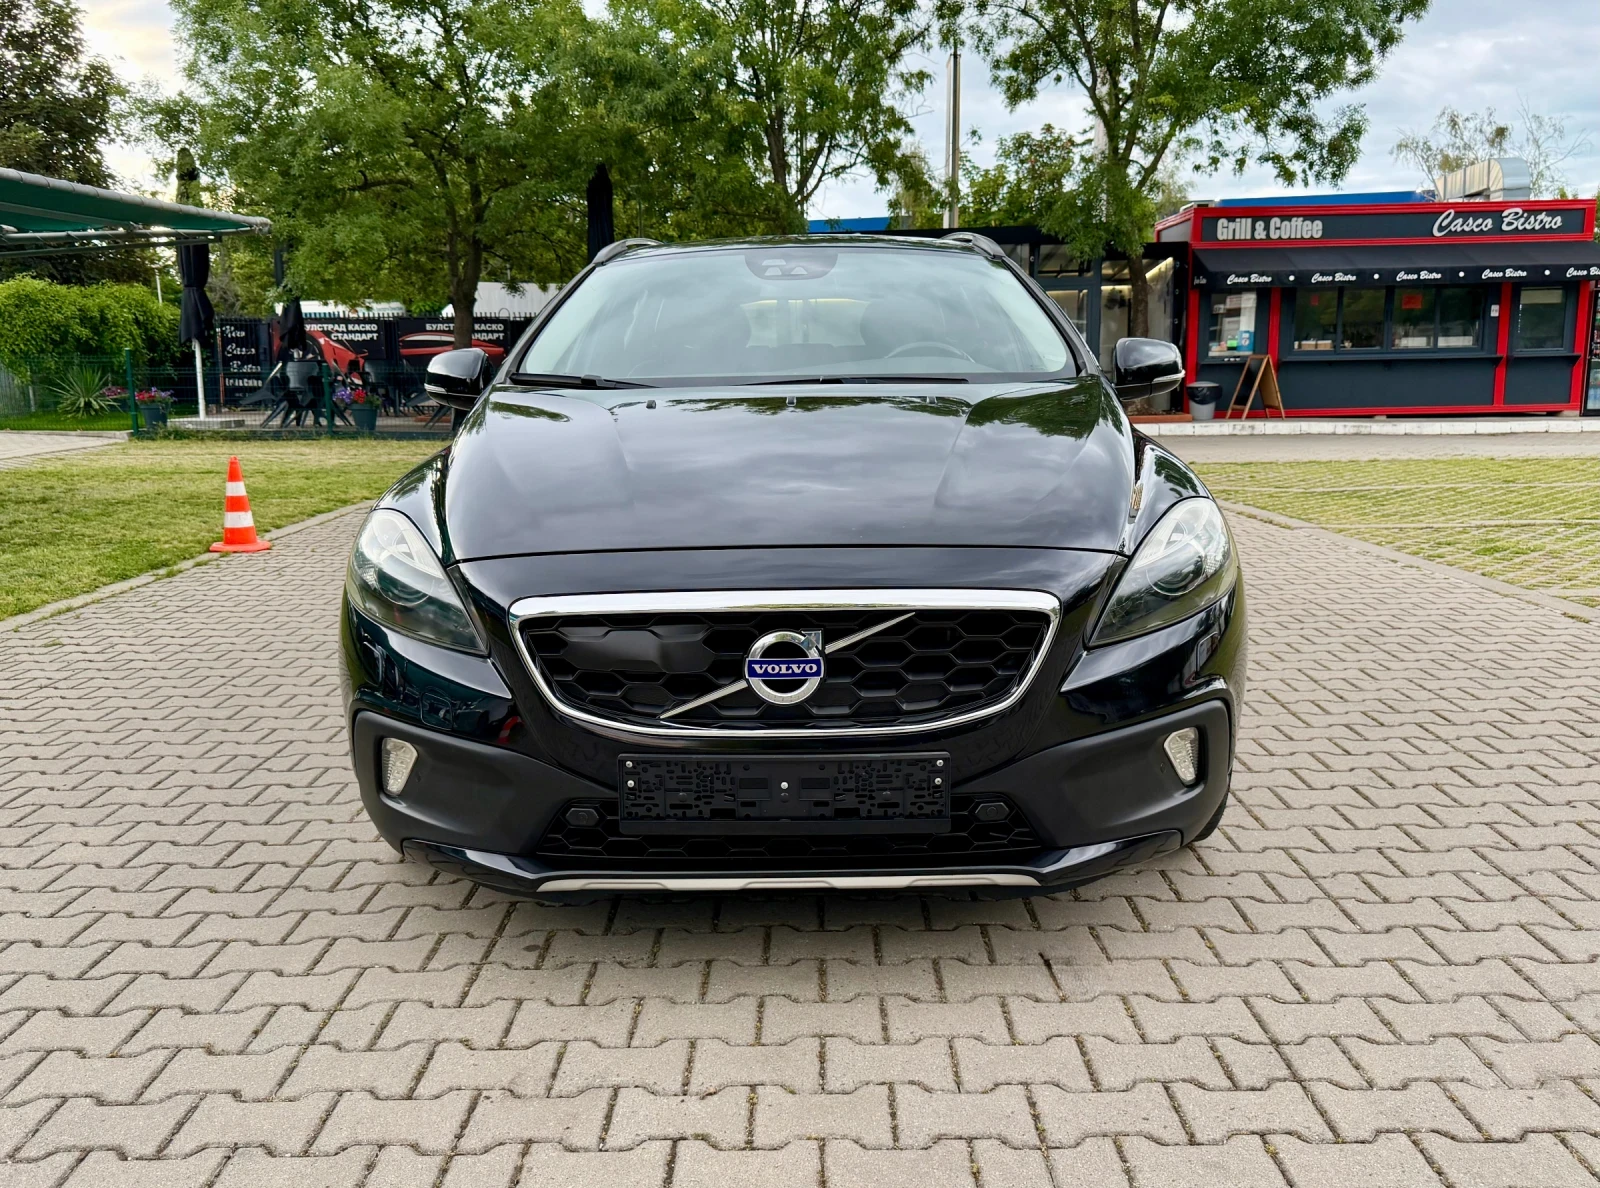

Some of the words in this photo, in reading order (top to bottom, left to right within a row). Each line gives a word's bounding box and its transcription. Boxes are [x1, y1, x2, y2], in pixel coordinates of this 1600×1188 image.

[1432, 209, 1493, 237] Casco
[1501, 207, 1563, 231] Bistro
[1216, 218, 1252, 240] Grill
[1254, 220, 1267, 239] &
[1269, 217, 1323, 239] Coffee
[1311, 272, 1333, 283] Casco
[1334, 272, 1357, 282] Bistro
[1396, 271, 1418, 282] Casco
[1419, 270, 1442, 280] Bistro
[1481, 268, 1504, 280] Casco
[1505, 268, 1527, 278] Bistro
[1566, 267, 1588, 278] Casco
[1226, 274, 1249, 285] Casco
[1250, 273, 1273, 283] Bistro
[303, 323, 347, 332] УЛСТРАД
[347, 323, 378, 331] КАСКО
[474, 323, 505, 331] КАСКО
[330, 332, 379, 341] СТАНДАРТ
[751, 663, 818, 674] VOLVO
